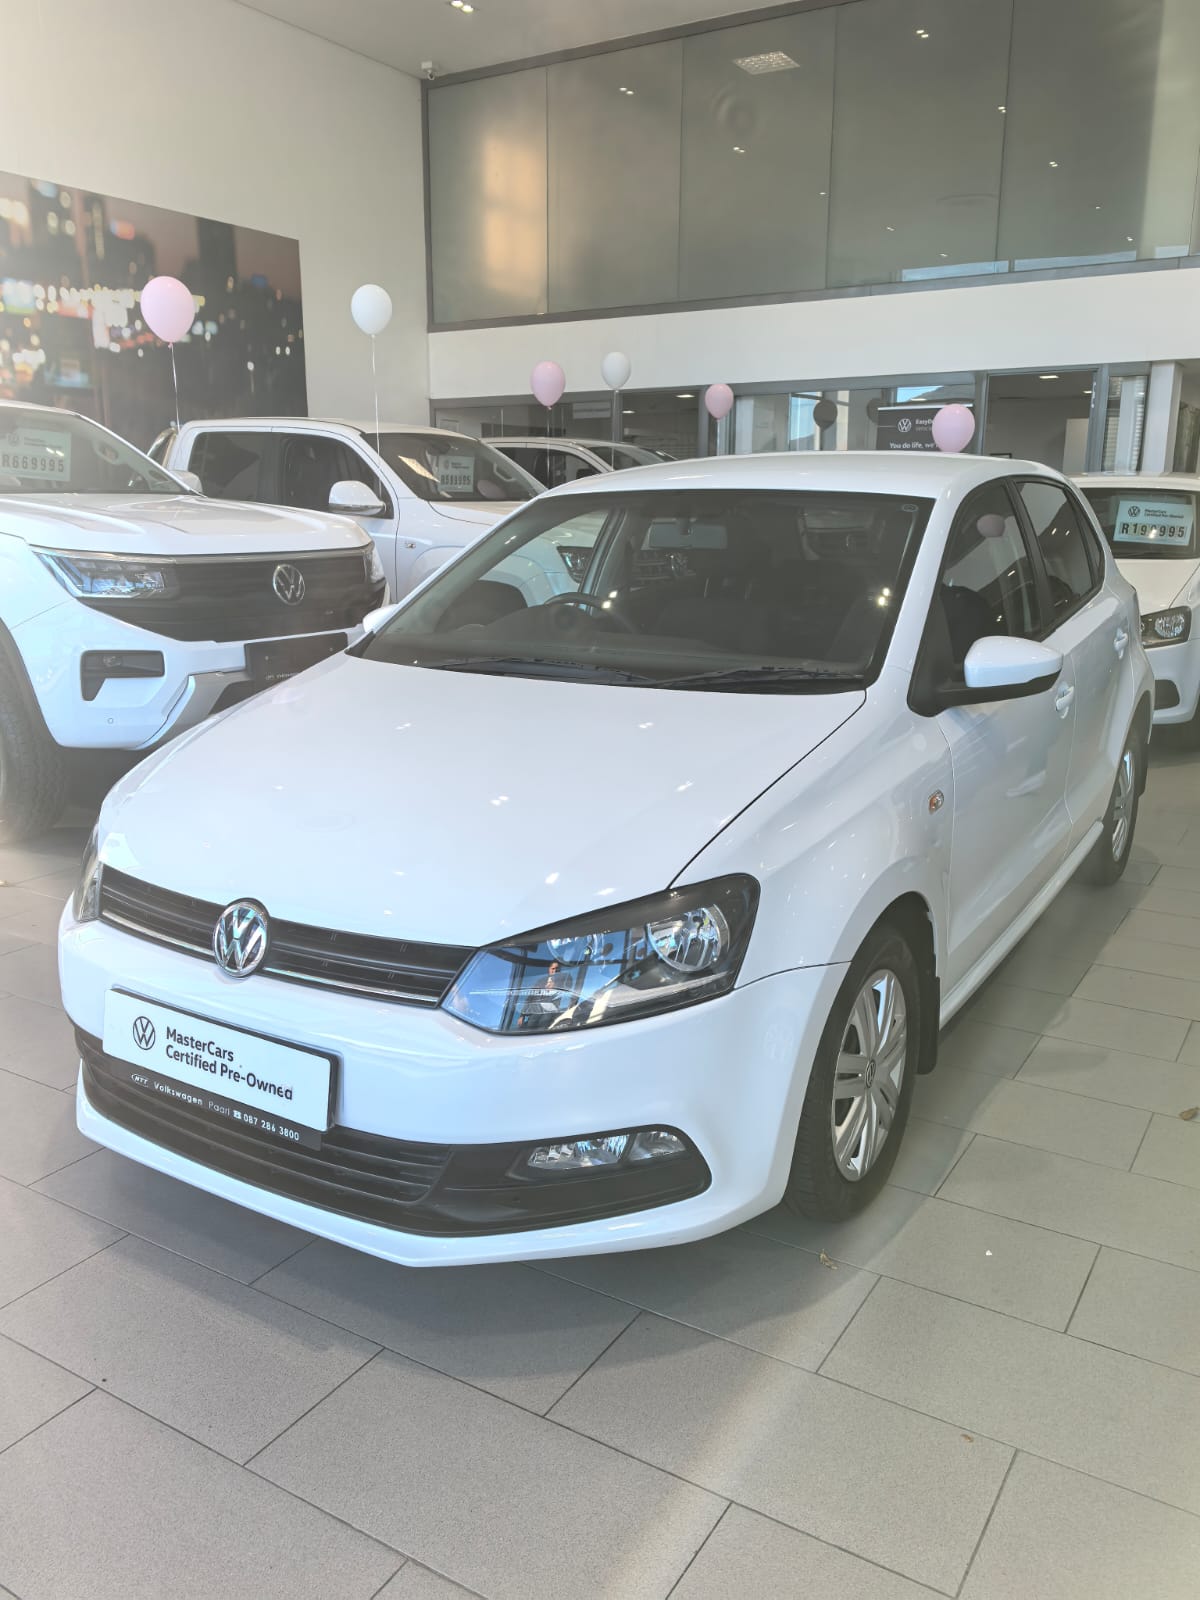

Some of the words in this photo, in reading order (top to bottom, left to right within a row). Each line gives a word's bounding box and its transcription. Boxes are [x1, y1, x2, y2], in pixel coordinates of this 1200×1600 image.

[165, 1044, 217, 1074] Certified
[220, 1063, 293, 1100] Pre-Owned
[166, 1026, 234, 1062] MasterCars
[153, 1081, 203, 1105] Volkswagen
[208, 1101, 230, 1116] Paarl
[243, 1113, 258, 1125] 087
[261, 1119, 276, 1132] 286
[279, 1126, 300, 1141] 3800
